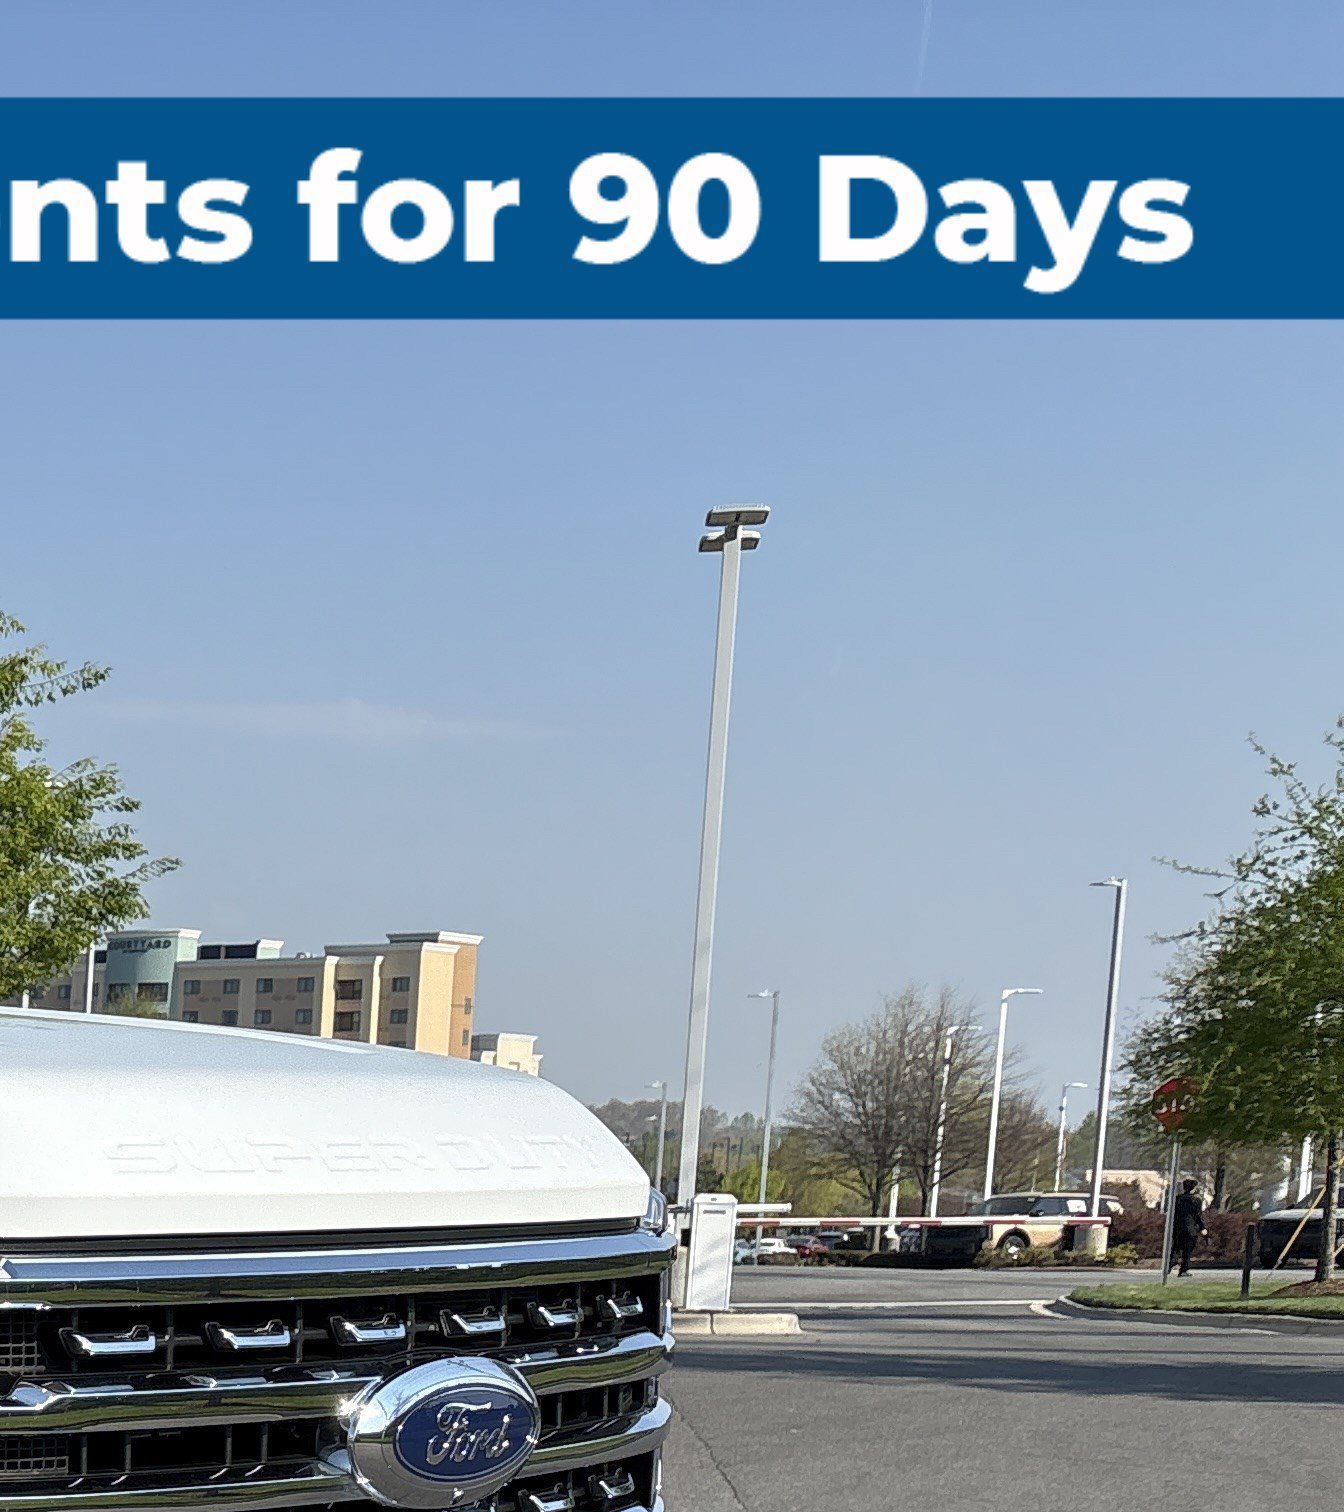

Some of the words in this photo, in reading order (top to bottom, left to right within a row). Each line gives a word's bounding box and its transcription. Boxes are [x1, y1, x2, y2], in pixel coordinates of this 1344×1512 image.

[108, 1134, 435, 1174] SUPER
[434, 1134, 602, 1171] DUTY
[426, 1401, 513, 1466] Ford
